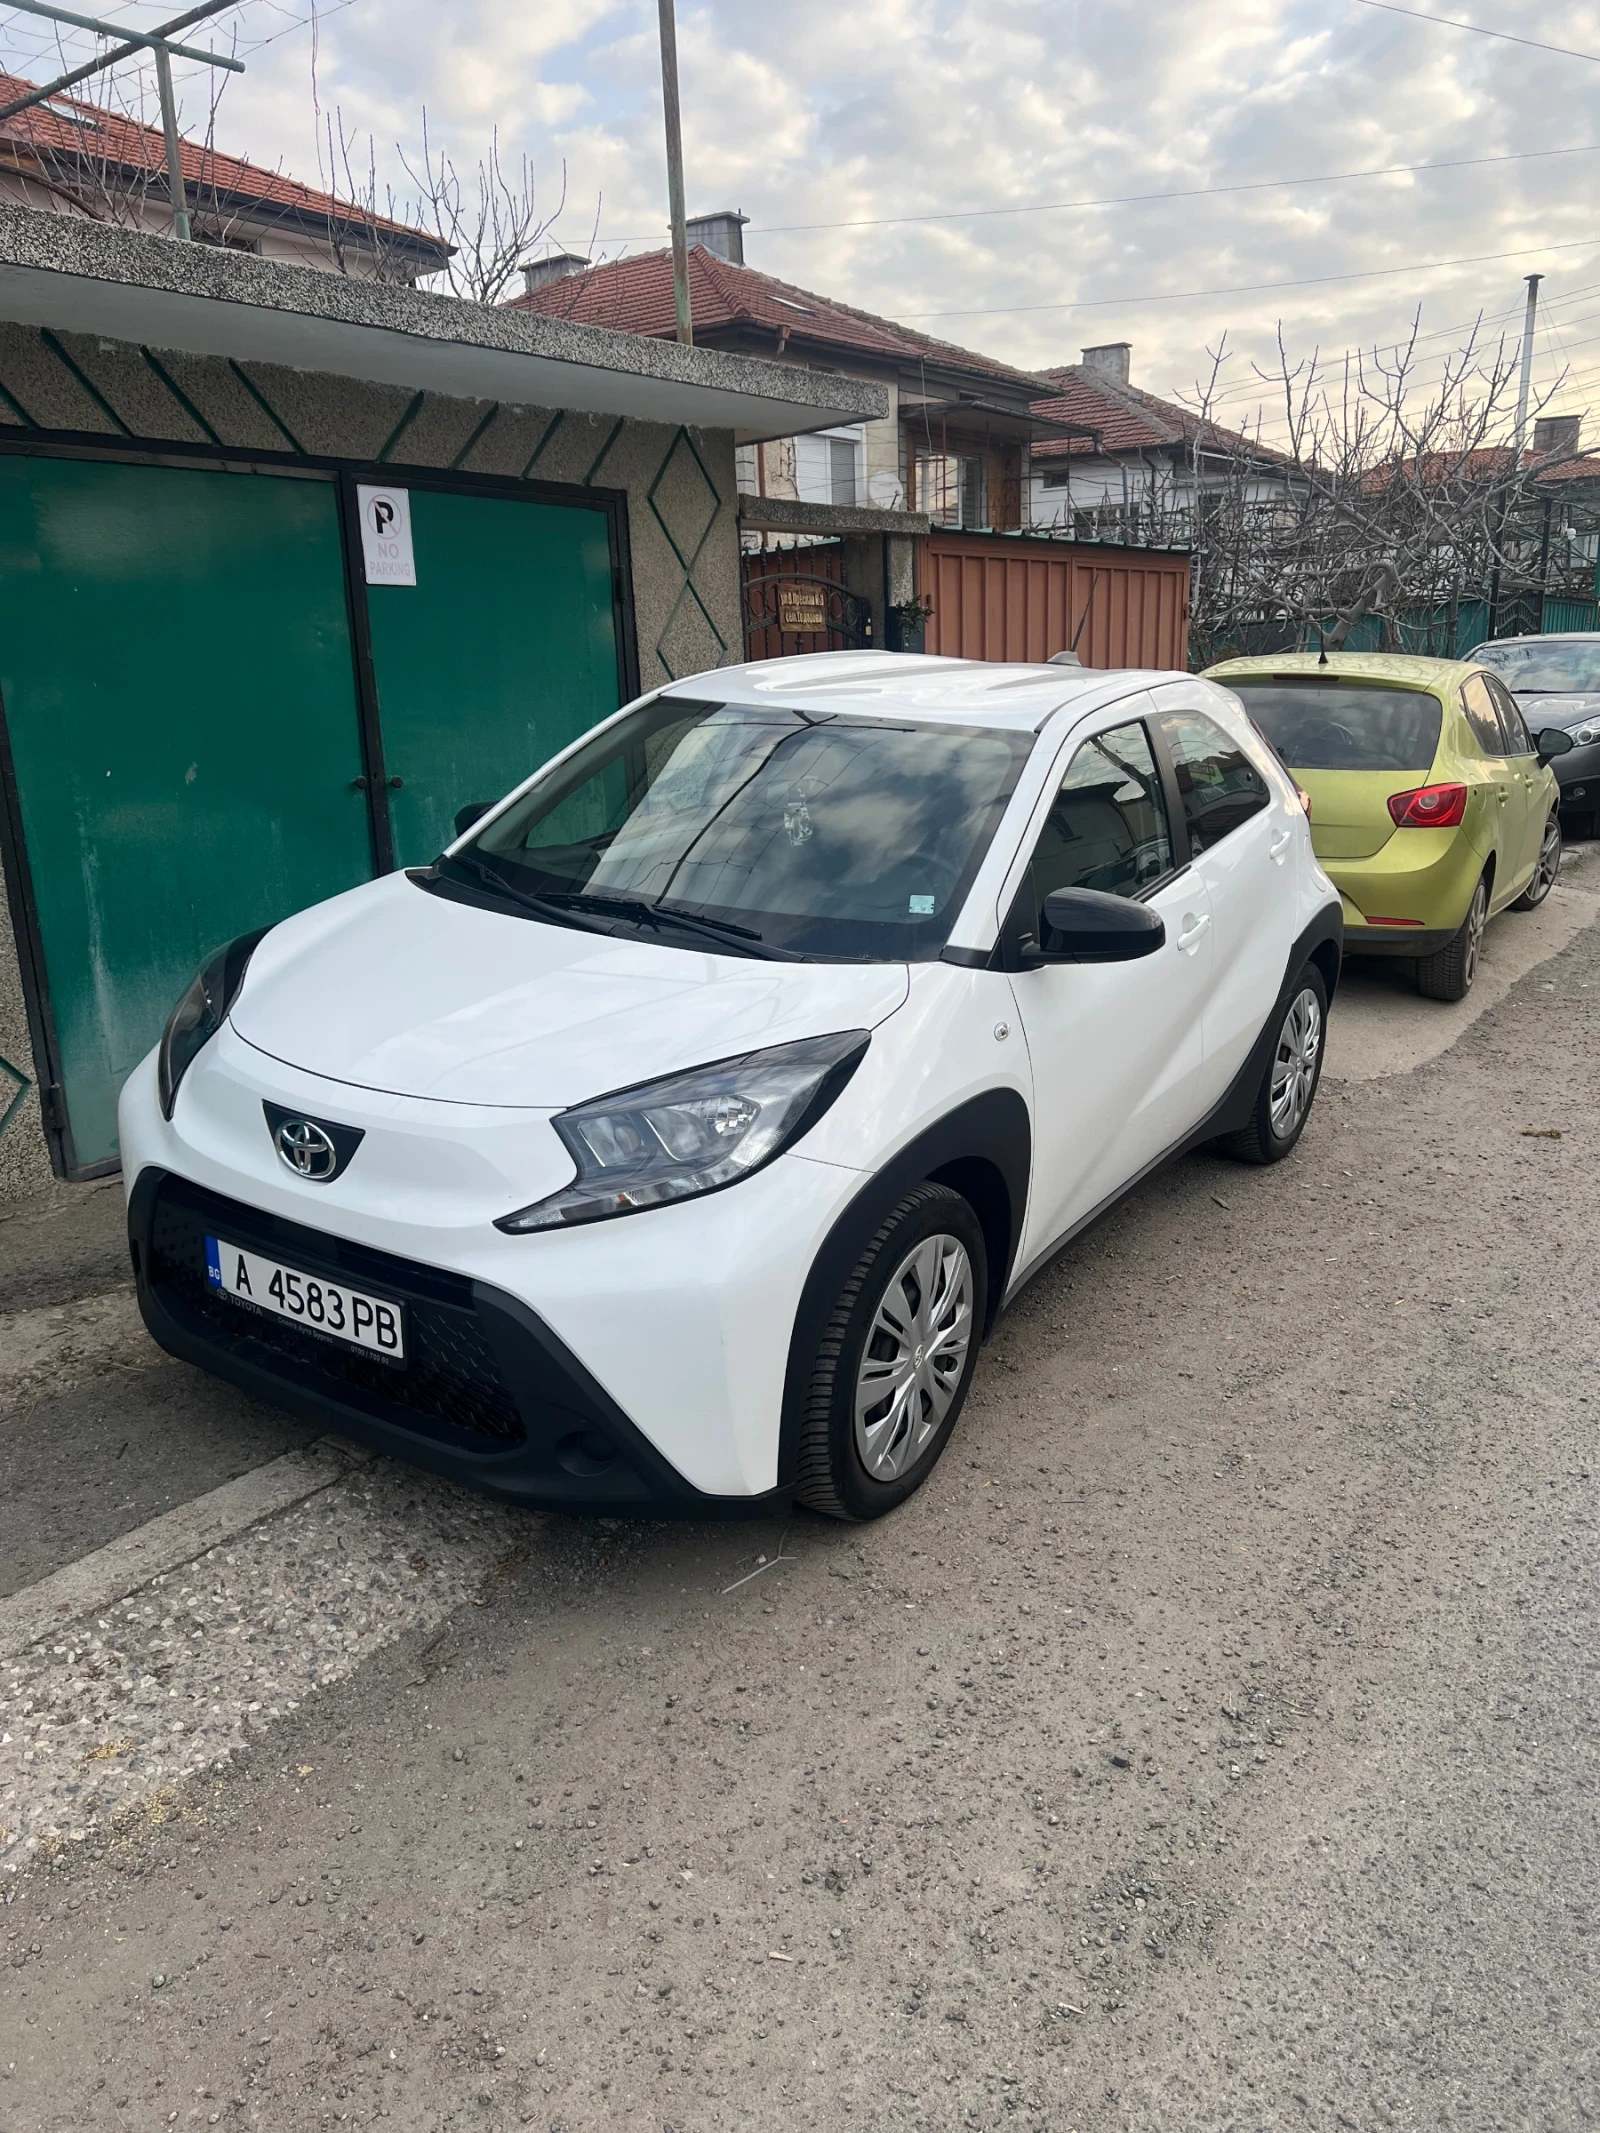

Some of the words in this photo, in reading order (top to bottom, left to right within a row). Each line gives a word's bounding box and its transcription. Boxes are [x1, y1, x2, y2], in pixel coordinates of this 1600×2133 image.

[378, 543, 399, 559] NO
[369, 561, 411, 577] PARKING
[208, 1265, 220, 1280] BG
[229, 1294, 263, 1317] TOYOTA
[236, 1253, 253, 1296] A
[268, 1268, 346, 1330] 4583
[352, 1296, 398, 1350] PB
